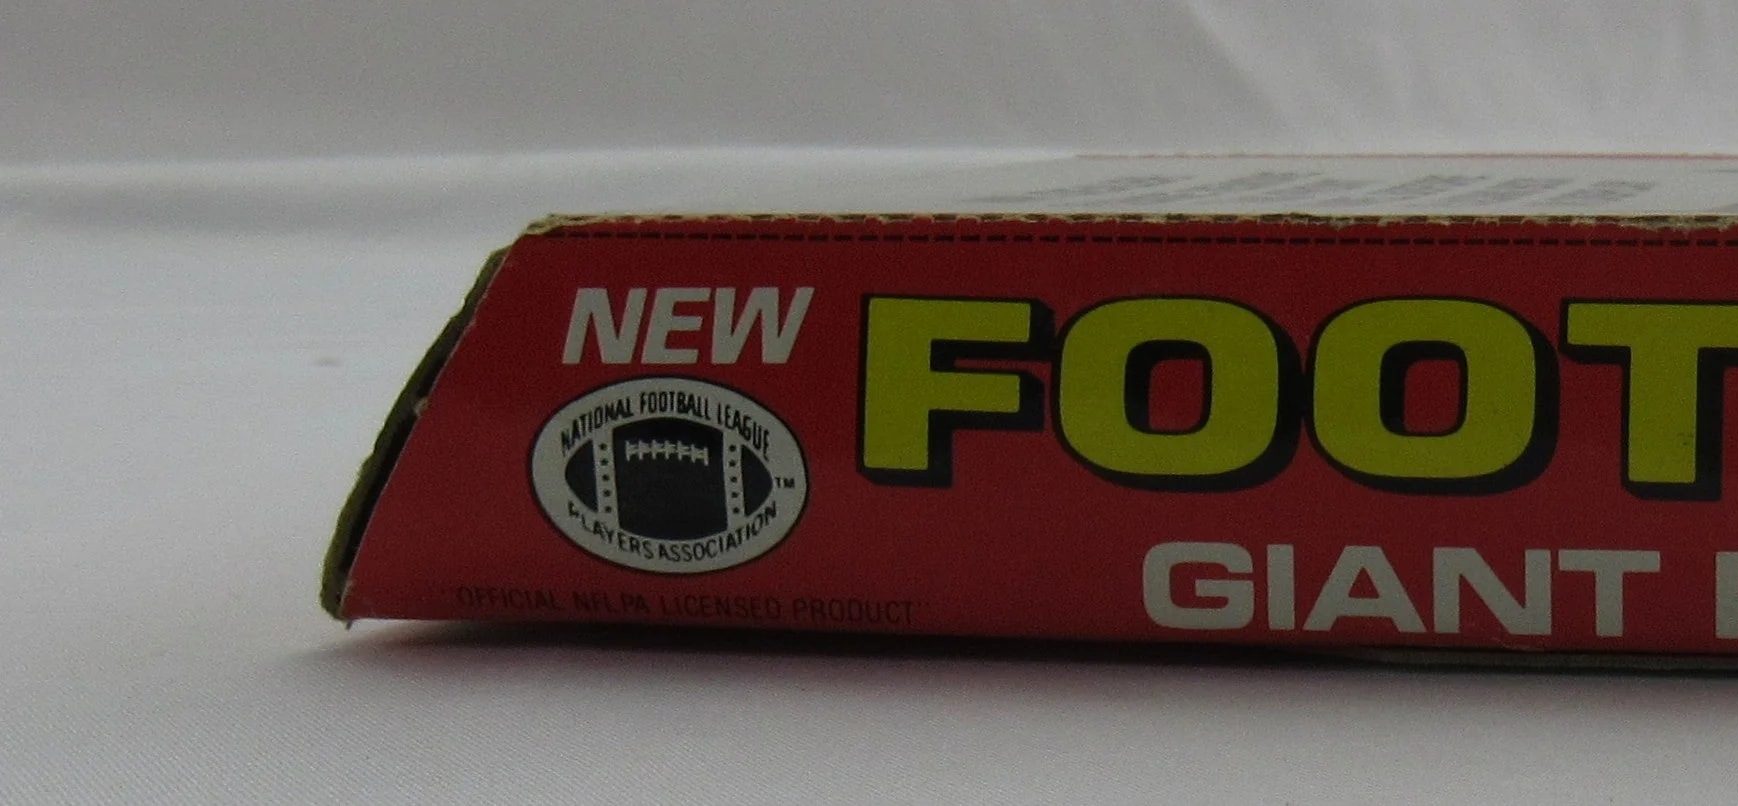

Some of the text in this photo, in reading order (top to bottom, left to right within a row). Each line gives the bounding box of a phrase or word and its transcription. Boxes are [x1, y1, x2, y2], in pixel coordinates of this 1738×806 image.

[561, 286, 815, 364] NEW
[560, 391, 770, 462] NATIONAL FOOTBALL LEAGUE
[567, 500, 778, 563] PLAYERS ASSOCIATION
[660, 591, 782, 622] LICENSED
[1142, 541, 1661, 638] GIANT
